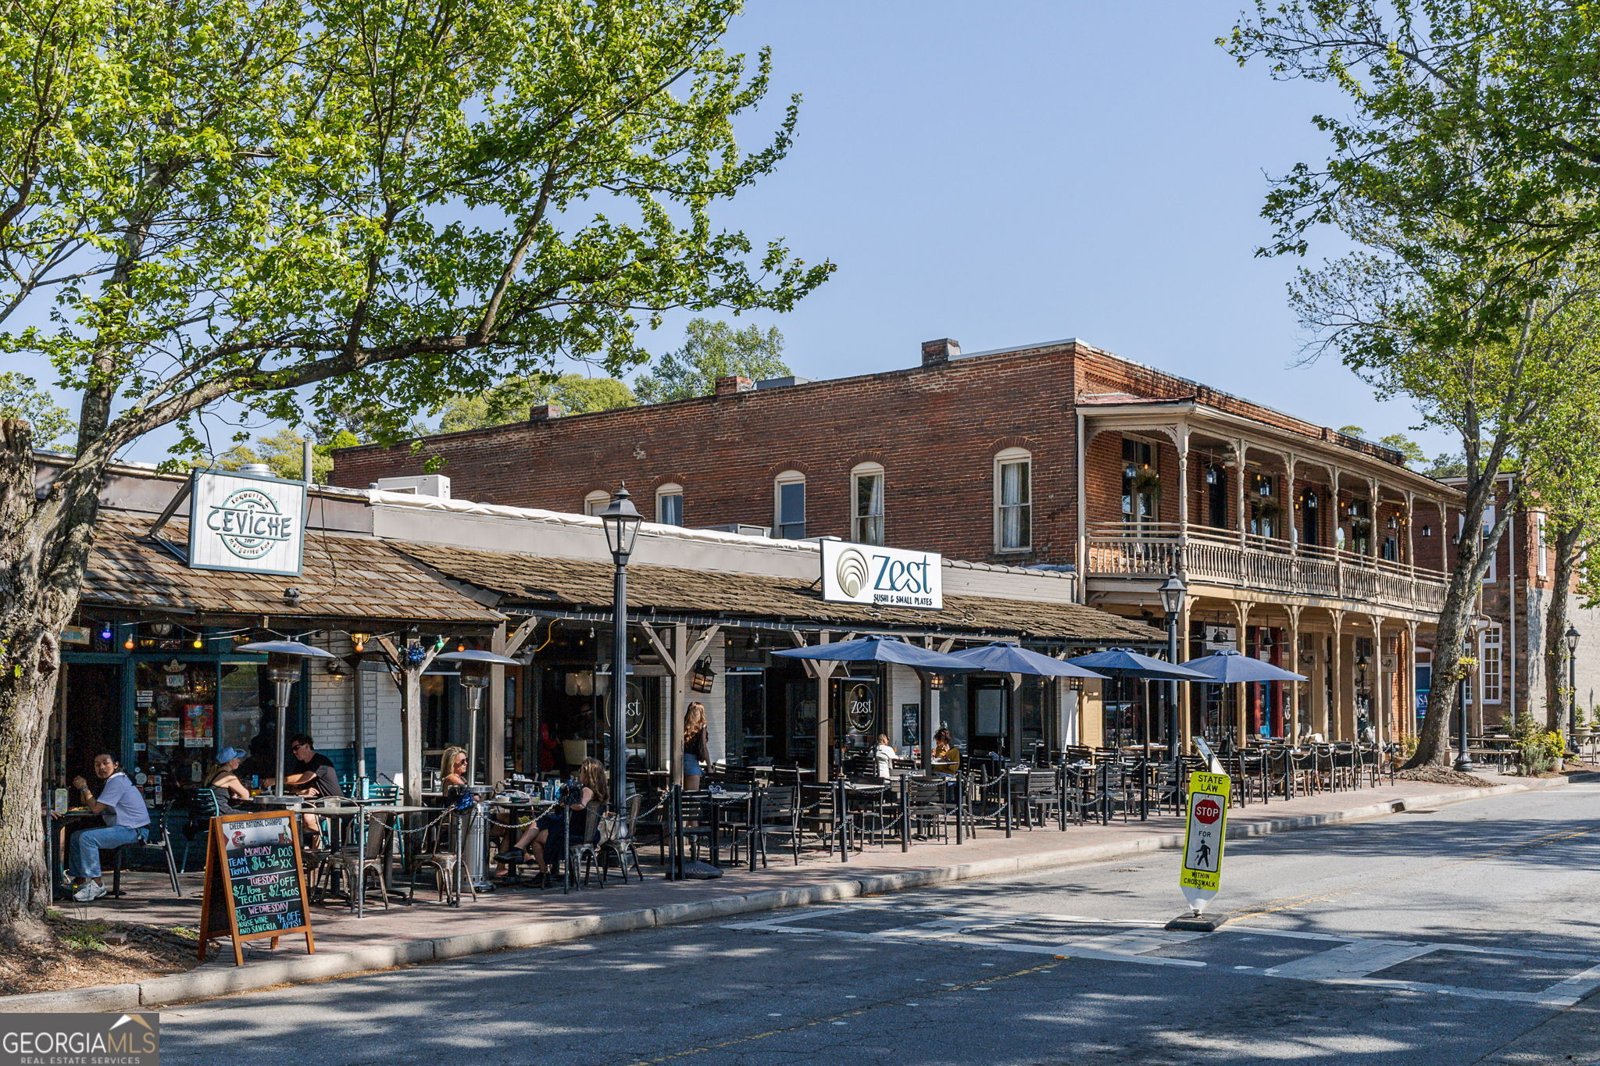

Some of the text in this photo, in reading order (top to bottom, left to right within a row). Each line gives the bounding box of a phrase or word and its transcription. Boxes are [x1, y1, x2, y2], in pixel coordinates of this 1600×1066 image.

[206, 509, 292, 538] CEVICHE
[872, 554, 932, 594] Zest
[873, 594, 889, 603] SUSHI
[896, 595, 912, 605] SMALL
[914, 597, 933, 606] PLATES
[1418, 694, 1429, 705] SA
[625, 699, 641, 716] st
[850, 699, 873, 714] Zest
[1198, 775, 1223, 784] STATE
[1201, 784, 1218, 792] LAW
[1196, 807, 1219, 817] STOP
[1199, 830, 1211, 838] FOR
[244, 846, 272, 856] MONDAY
[277, 846, 293, 857] DOS
[228, 856, 248, 867] TEAM
[280, 858, 292, 869] XX
[248, 874, 279, 886] TUESDAY
[1191, 871, 1210, 879] WITHIN
[269, 876, 296, 897] $2 OFF
[1183, 878, 1216, 888] CROSSWALK
[232, 884, 245, 897] $2
[280, 887, 299, 897] TACOS
[238, 893, 267, 905] TECATE
[248, 901, 289, 915] WEDNESDAY
[286, 911, 301, 921] OFF
[251, 922, 277, 933] SANGRIA
